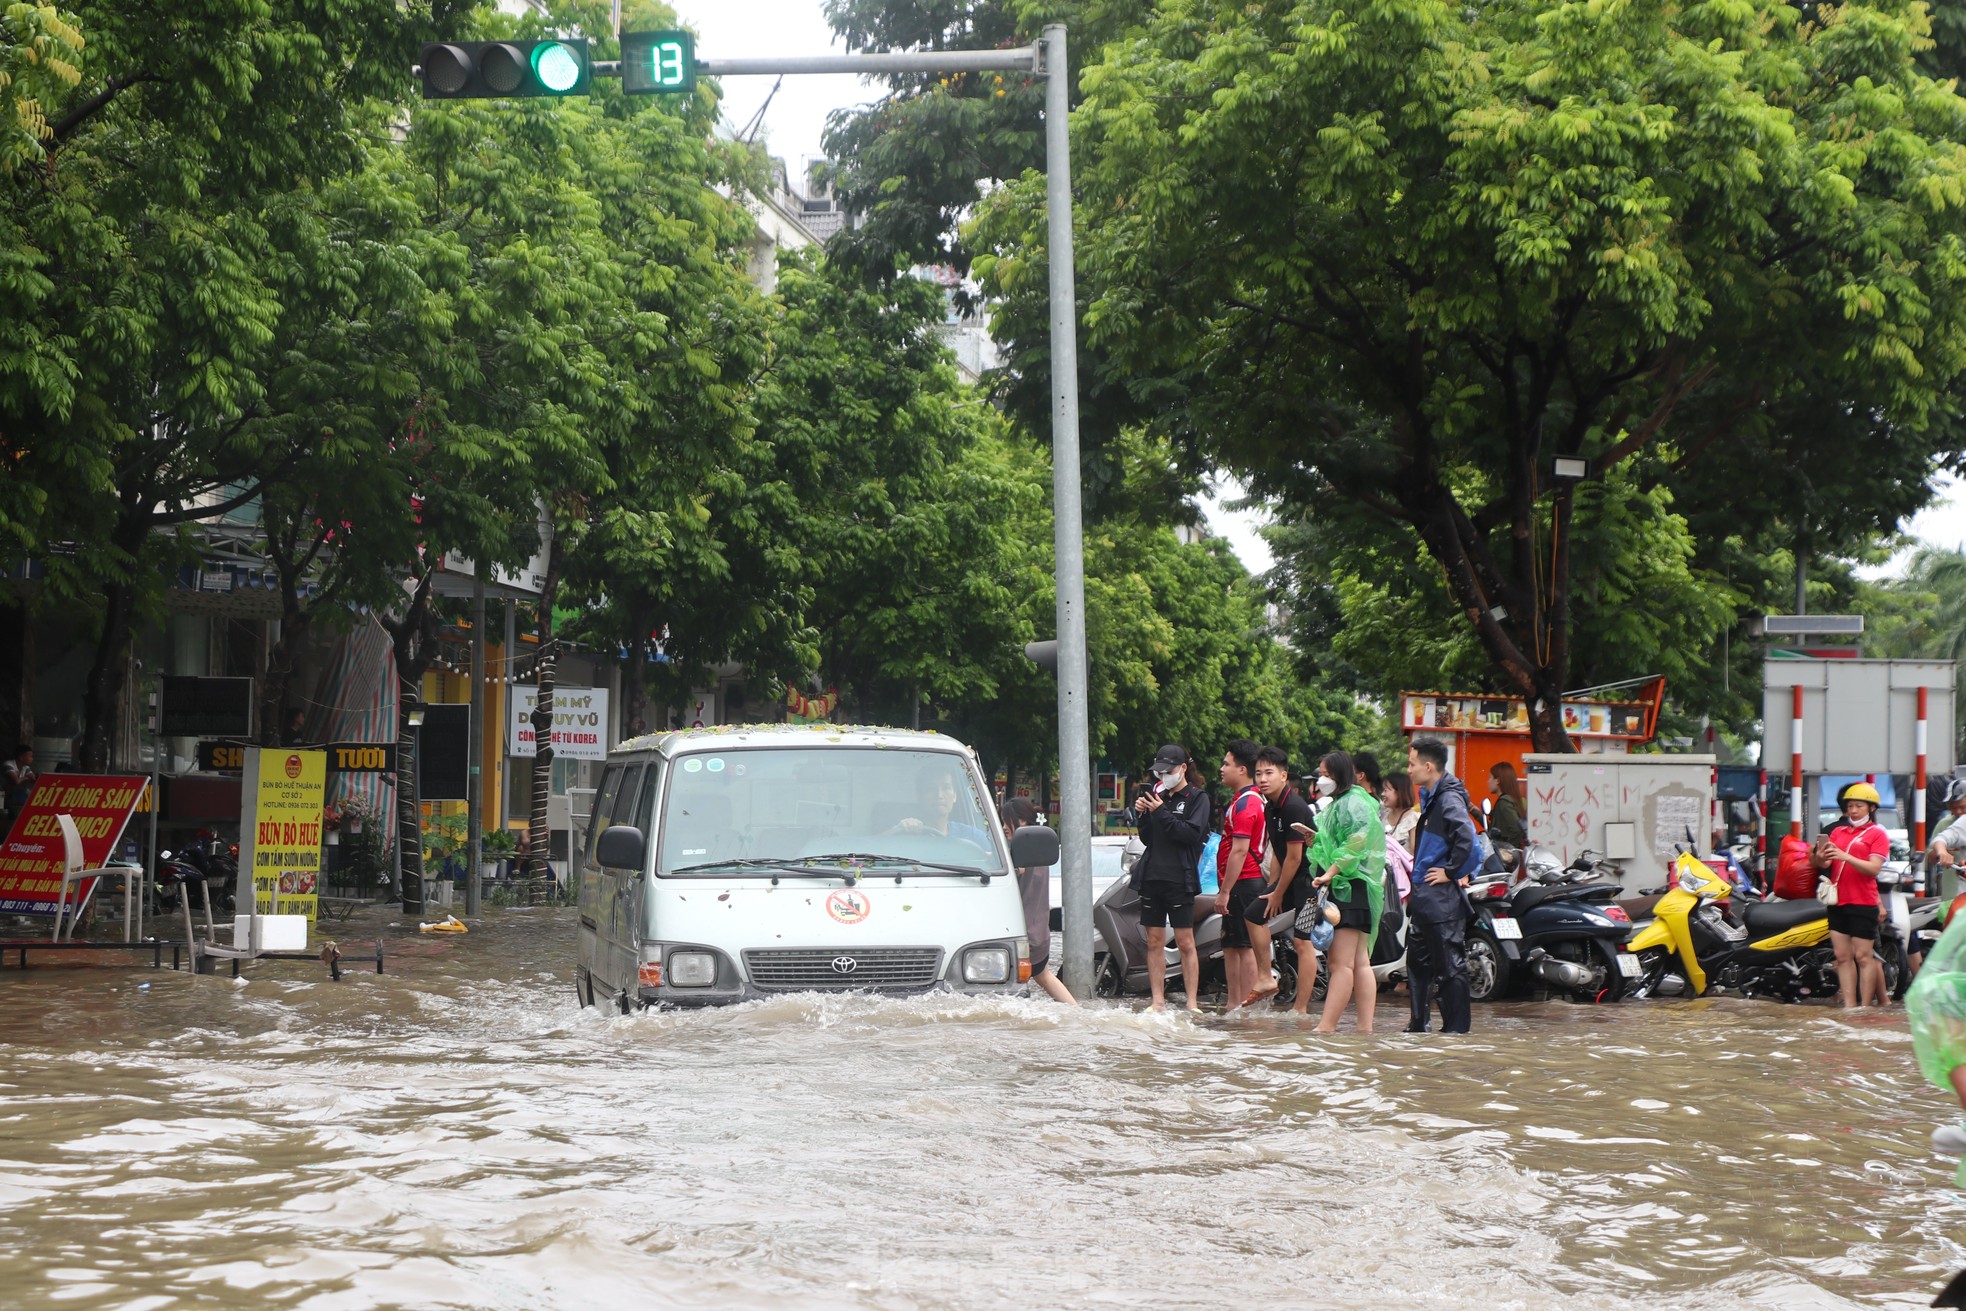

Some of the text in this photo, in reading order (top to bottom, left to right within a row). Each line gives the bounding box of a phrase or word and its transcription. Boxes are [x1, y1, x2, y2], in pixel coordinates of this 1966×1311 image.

[653, 42, 683, 85] 13
[570, 695, 593, 708] MỸ
[551, 713, 575, 726] UY
[577, 711, 599, 727] VŨ
[573, 733, 598, 745] KOREA
[336, 747, 386, 769] TƯƠI
[31, 780, 64, 808] BẤT
[60, 783, 105, 812] ĐỘNG
[101, 781, 136, 809] SẢN
[264, 801, 287, 809] HOTLINE:
[258, 813, 320, 846] BÚN BÒ HUẾ
